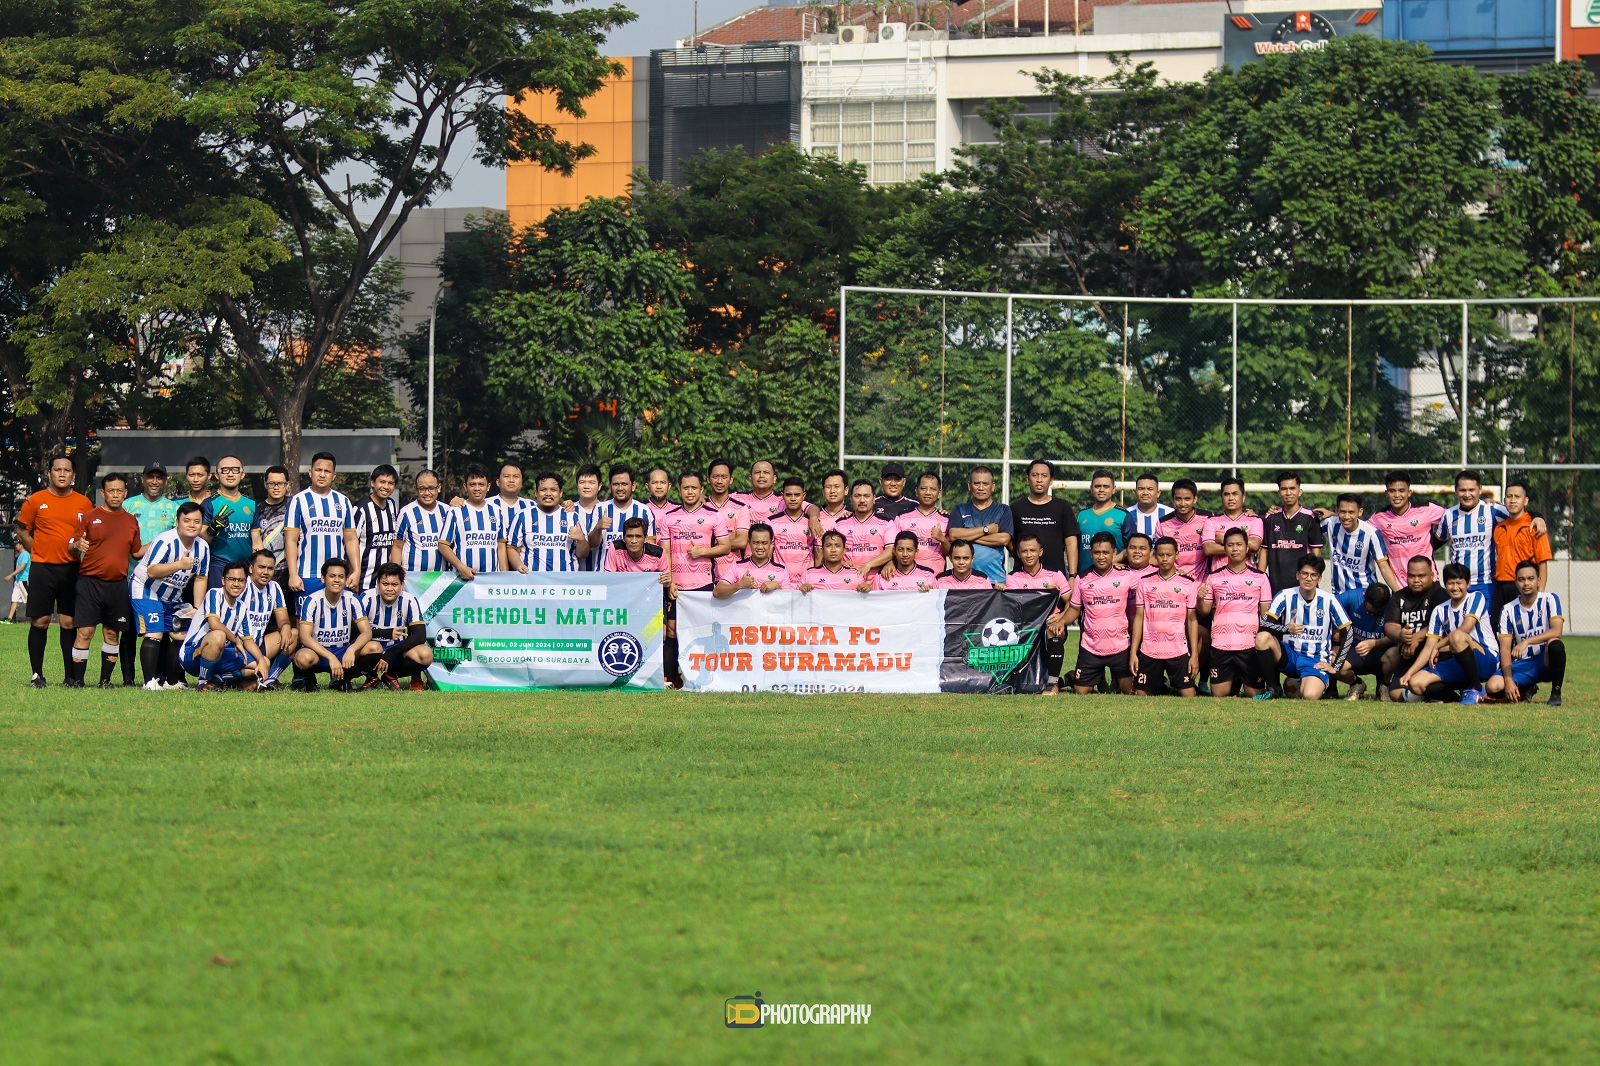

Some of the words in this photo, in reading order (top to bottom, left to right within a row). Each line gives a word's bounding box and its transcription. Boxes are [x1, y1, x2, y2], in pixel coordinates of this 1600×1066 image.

[1254, 41, 1299, 55] Watch
[420, 535, 438, 543] PRA
[466, 533, 497, 541] PRABU
[532, 534, 567, 542] PRABU
[607, 534, 622, 542] PRA
[1453, 535, 1486, 544] PRABU
[487, 588, 537, 596] RSUDMA
[542, 588, 556, 596] FC
[562, 588, 592, 596] TOUR
[148, 612, 160, 623] 25
[452, 607, 547, 626] FRIENDLY
[556, 607, 628, 626] MATCH
[729, 626, 838, 645] RSUDMA
[849, 626, 881, 645] FC
[478, 641, 508, 649] MINGGU,
[488, 656, 544, 664] BOGOWONTO
[546, 656, 591, 664] SURABAYA
[689, 652, 753, 672] TOUR
[763, 652, 913, 672] SURAMADU
[1138, 673, 1147, 684] 21
